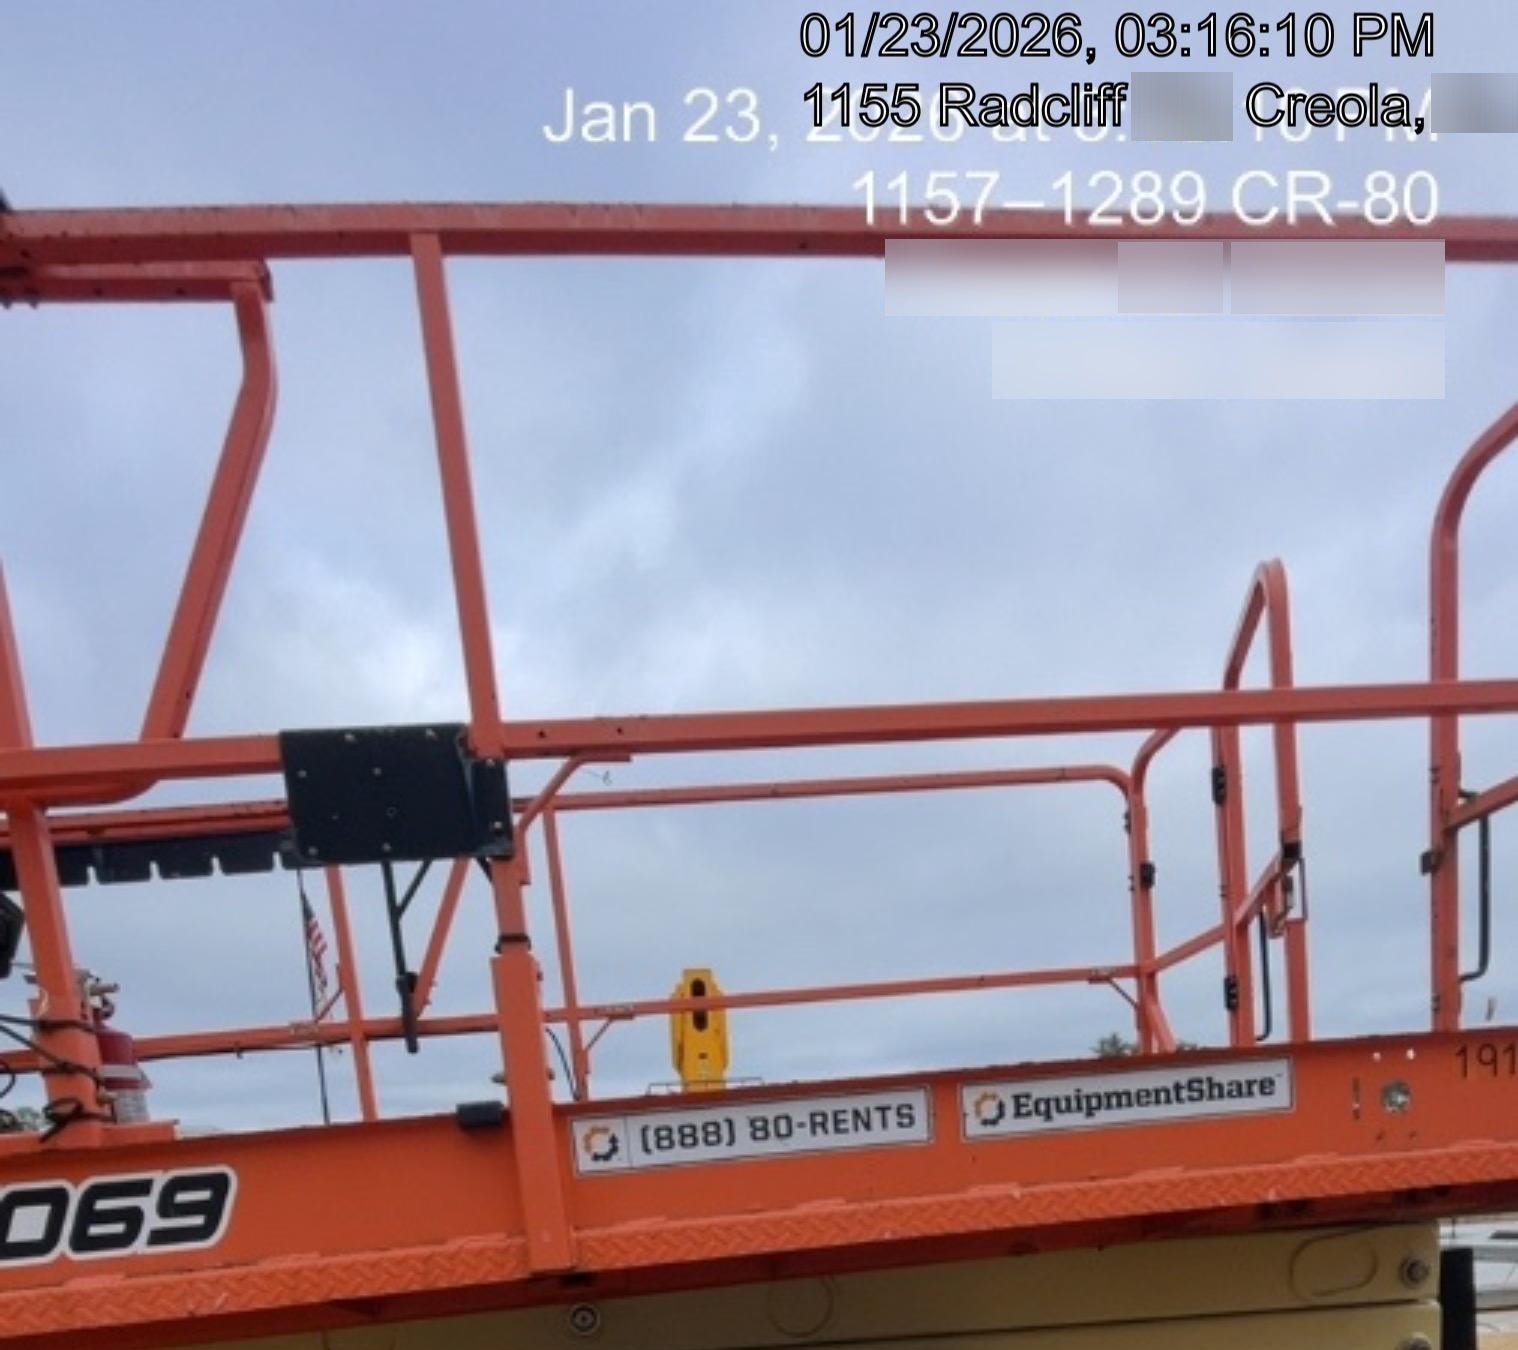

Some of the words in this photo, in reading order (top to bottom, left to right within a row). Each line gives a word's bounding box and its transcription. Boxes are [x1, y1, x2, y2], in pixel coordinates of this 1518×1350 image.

[1456, 1043, 1516, 1078] 191
[1012, 1076, 1276, 1122] EquipmentShare
[641, 1117, 736, 1155] (888)
[750, 1103, 915, 1141] 80-RENTS
[0, 1171, 231, 1260] 069
